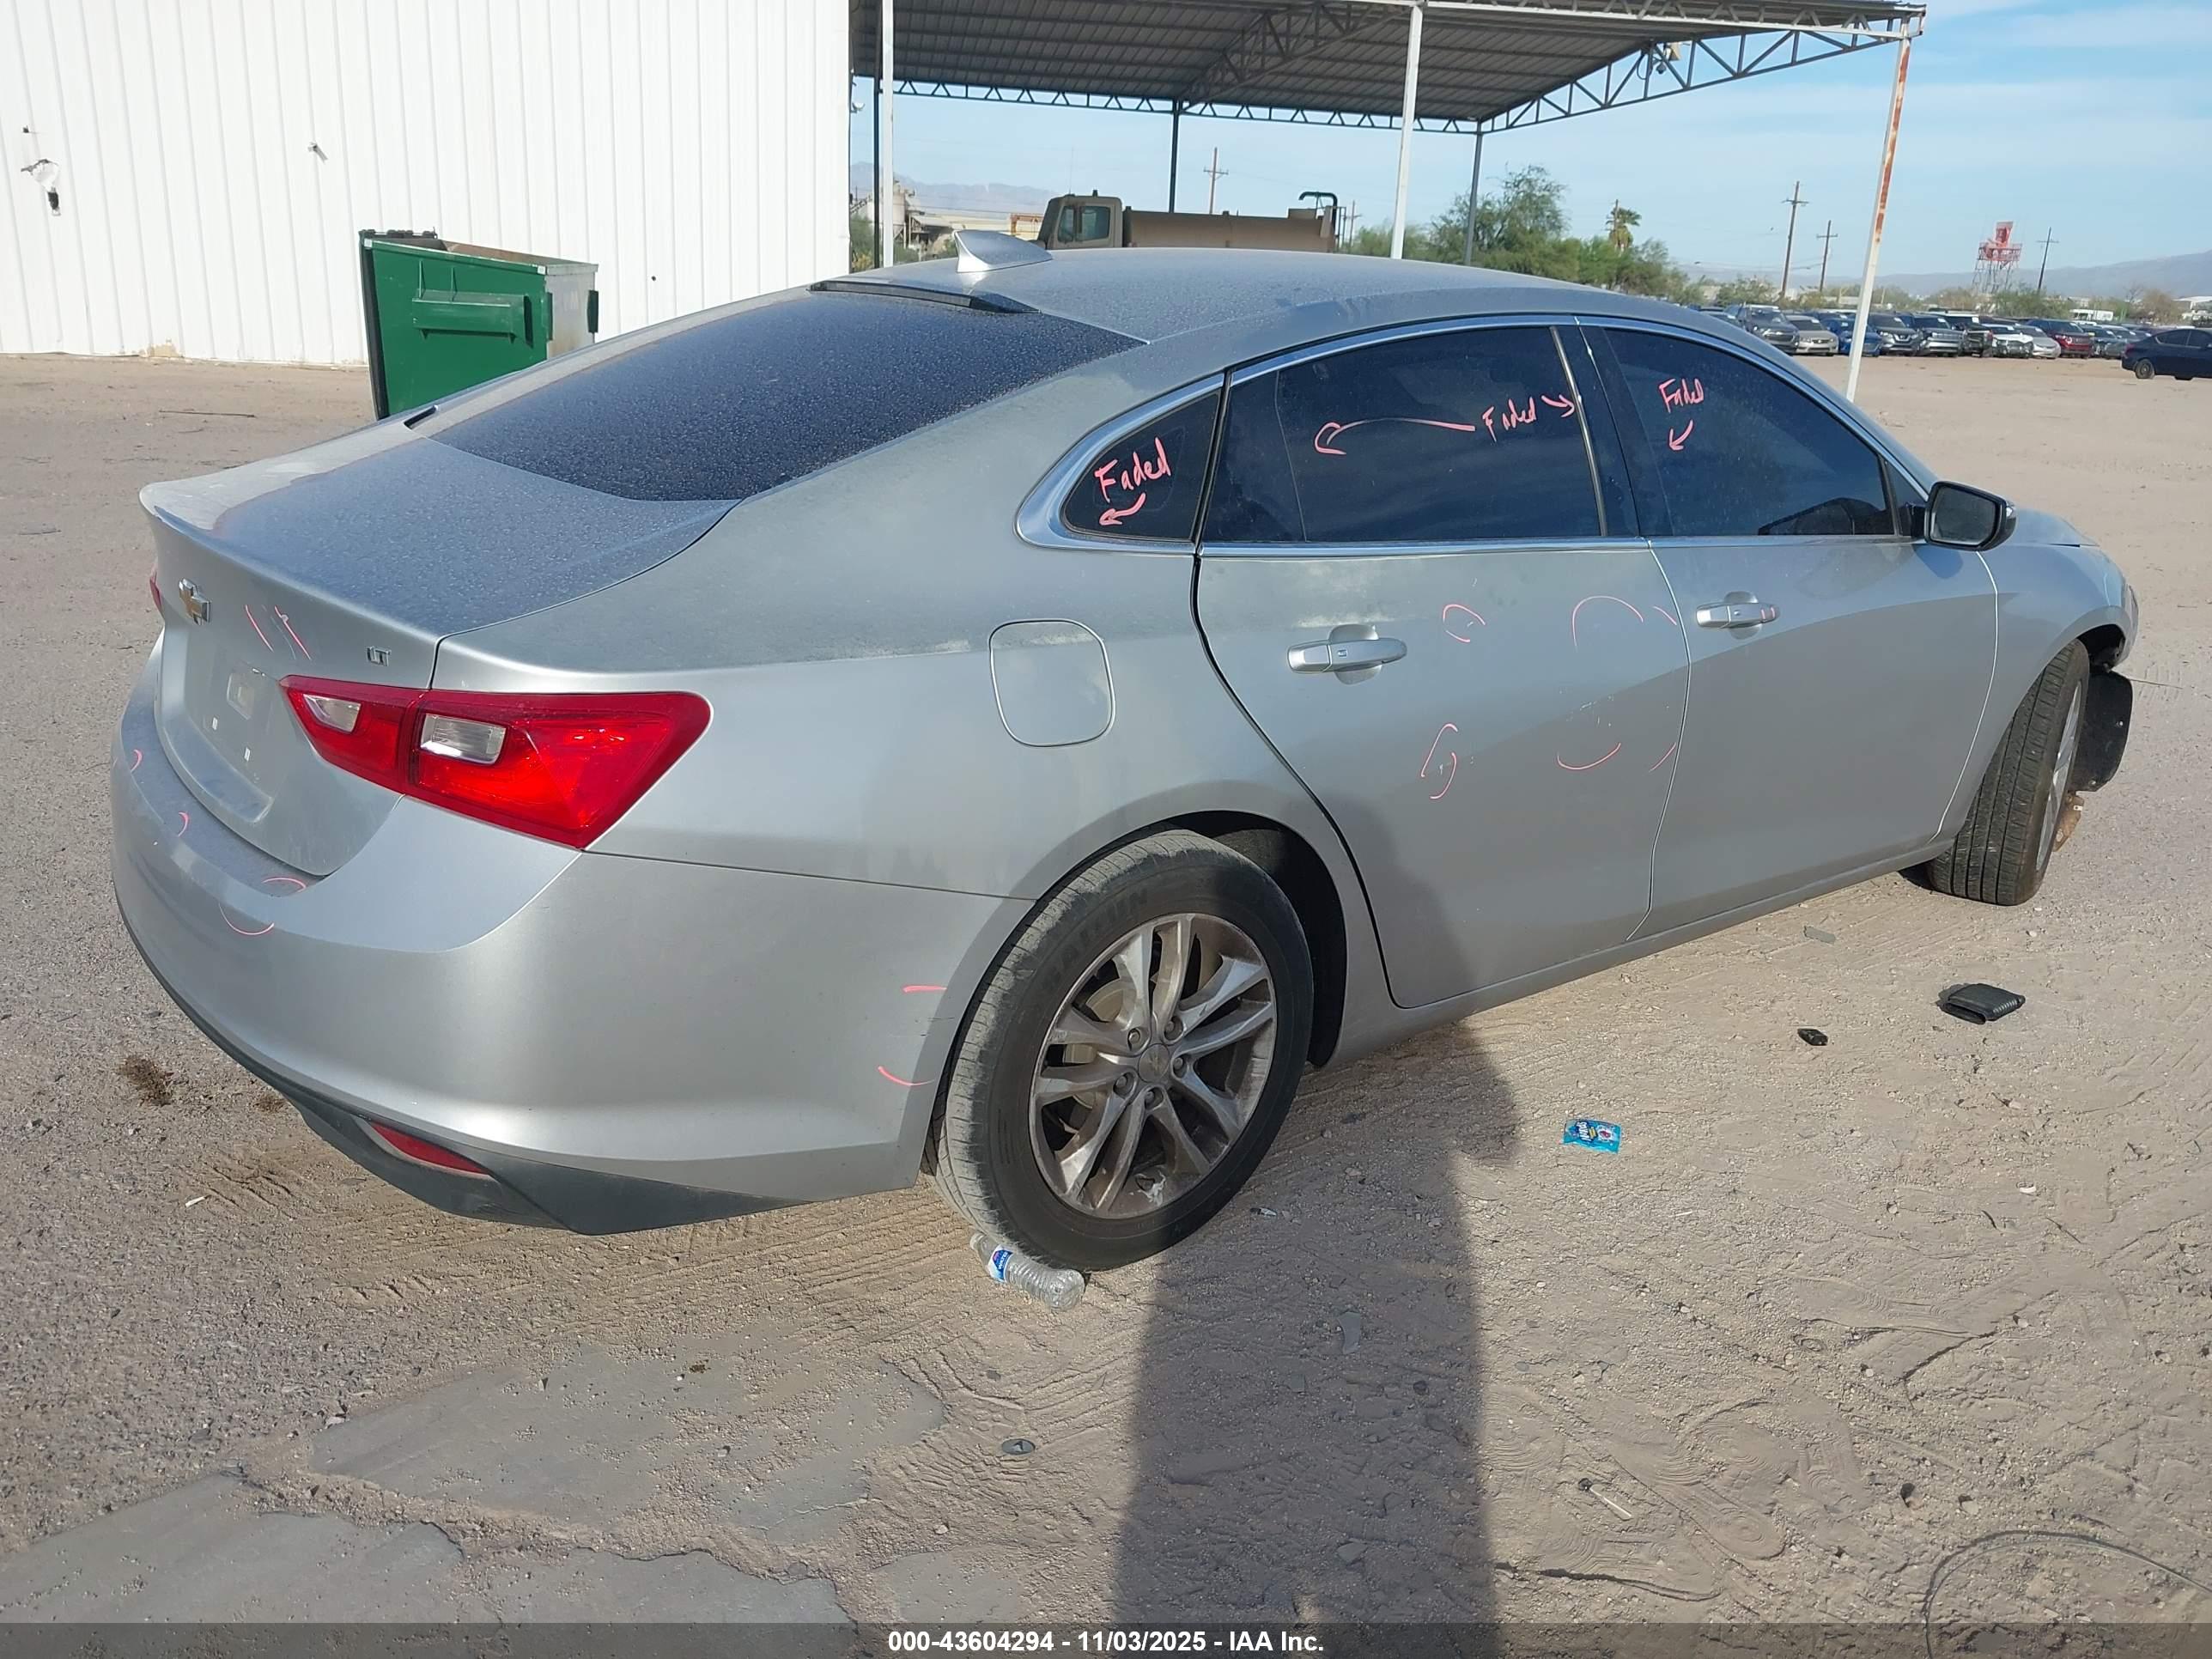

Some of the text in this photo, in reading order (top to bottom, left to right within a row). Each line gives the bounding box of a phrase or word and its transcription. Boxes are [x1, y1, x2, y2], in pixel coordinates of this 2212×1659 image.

[1657, 378, 1704, 413] Faded
[1094, 436, 1172, 503] Faded
[366, 646, 392, 667] LT
